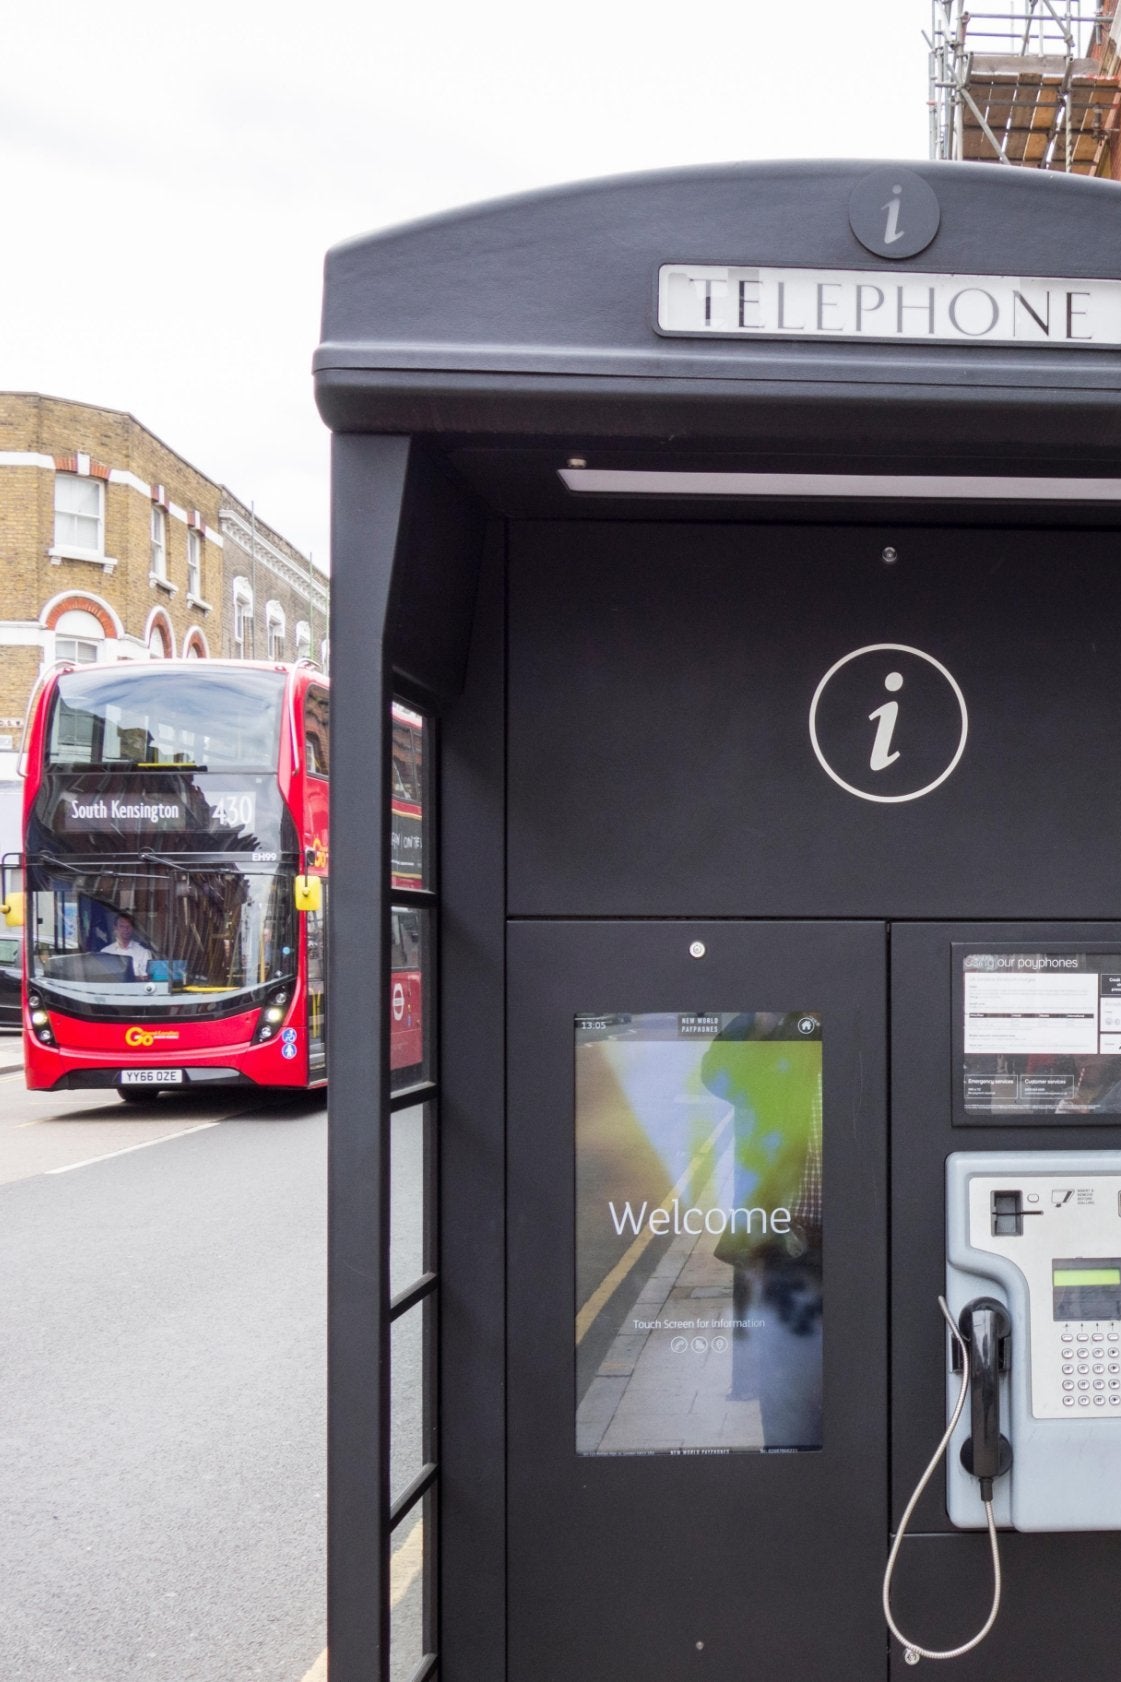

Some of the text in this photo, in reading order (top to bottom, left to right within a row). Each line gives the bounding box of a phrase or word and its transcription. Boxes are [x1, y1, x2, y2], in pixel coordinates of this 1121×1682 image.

[689, 277, 1093, 341] TELEPHONE
[71, 796, 253, 825] South Kensington 430
[997, 959, 1014, 967] our
[1018, 957, 1078, 970] payphones
[581, 1021, 606, 1029] 13:05
[125, 1027, 154, 1046] Go
[126, 1071, 154, 1082] YY66
[609, 1199, 792, 1236] Welcome
[633, 1319, 661, 1329] Touch
[664, 1319, 694, 1329] Screen
[696, 1319, 710, 1329] for
